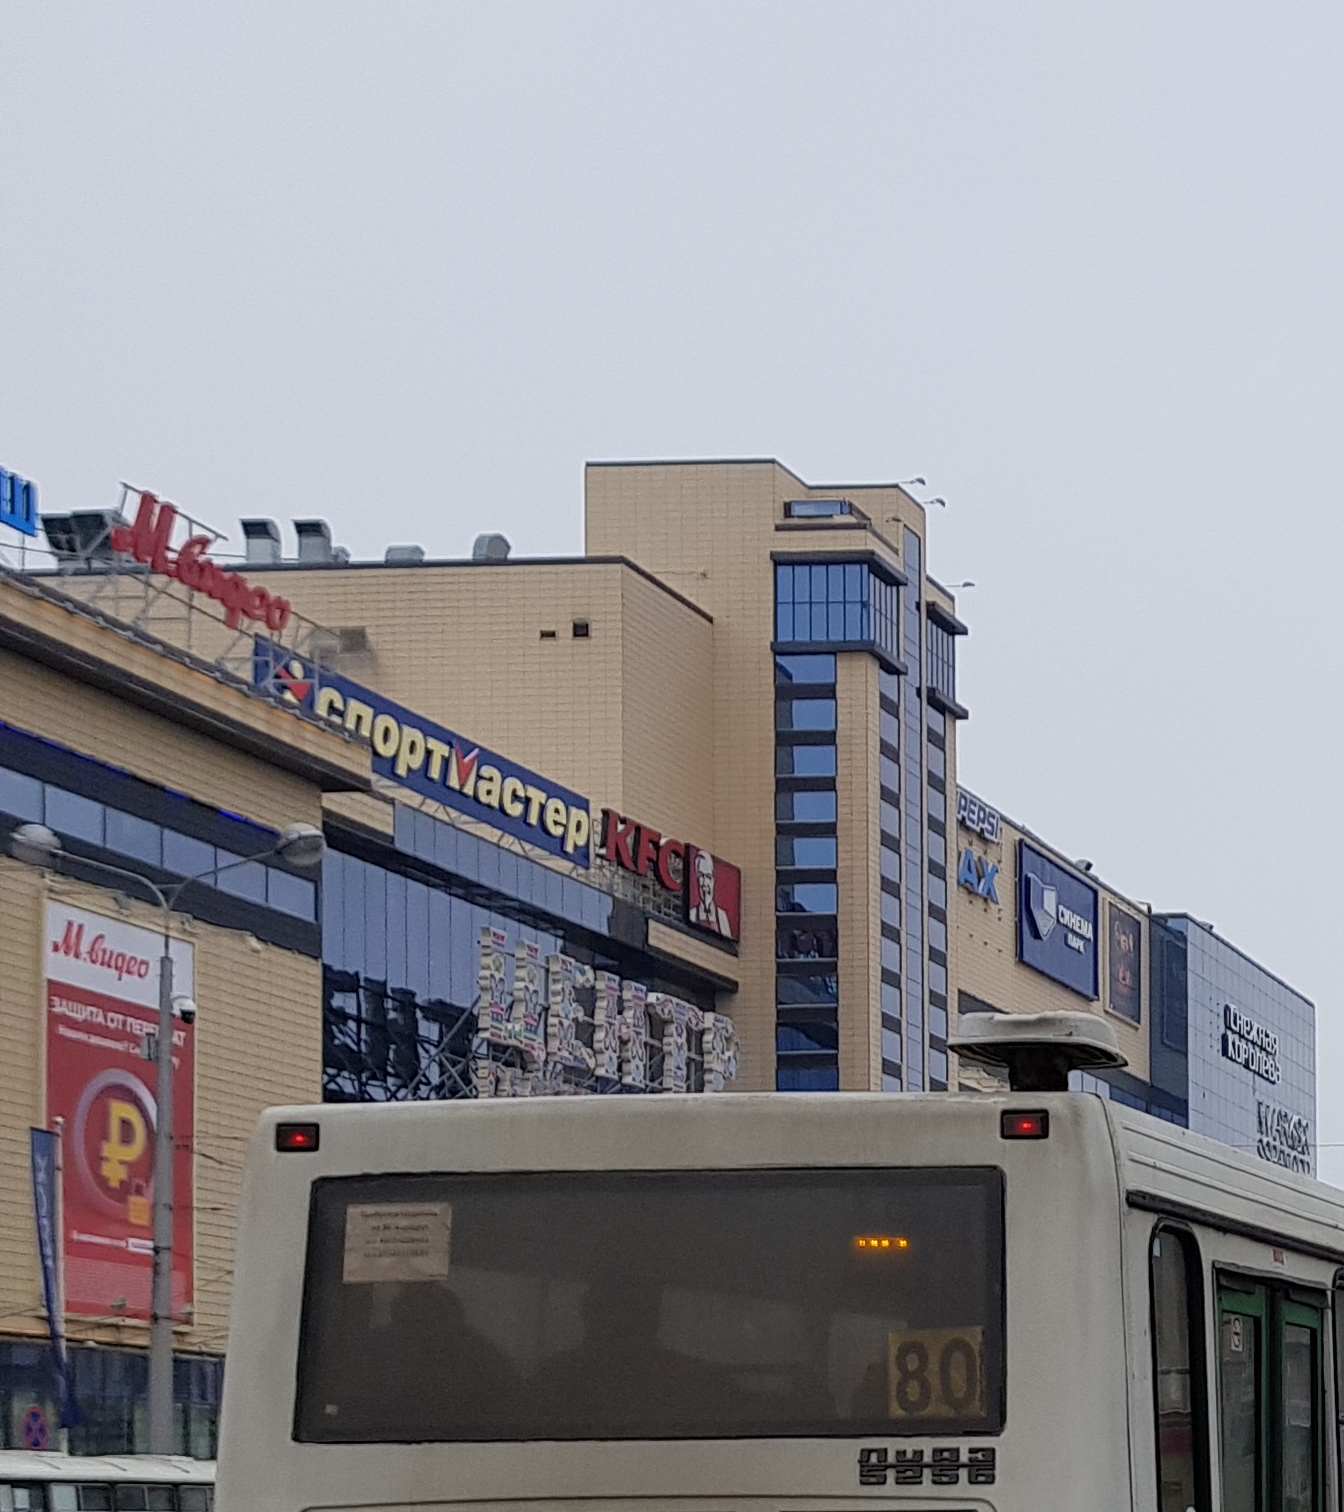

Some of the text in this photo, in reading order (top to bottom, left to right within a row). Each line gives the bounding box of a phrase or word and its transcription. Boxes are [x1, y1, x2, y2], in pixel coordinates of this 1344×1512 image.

[958, 790, 999, 841] PEPSI
[601, 808, 685, 893] KFC
[1058, 904, 1094, 942] СИНЕМА
[1067, 932, 1086, 954] ПАРК
[50, 995, 105, 1026] ЗАЩИТА
[107, 1010, 124, 1030] ОТ
[895, 1336, 978, 1416] 80
